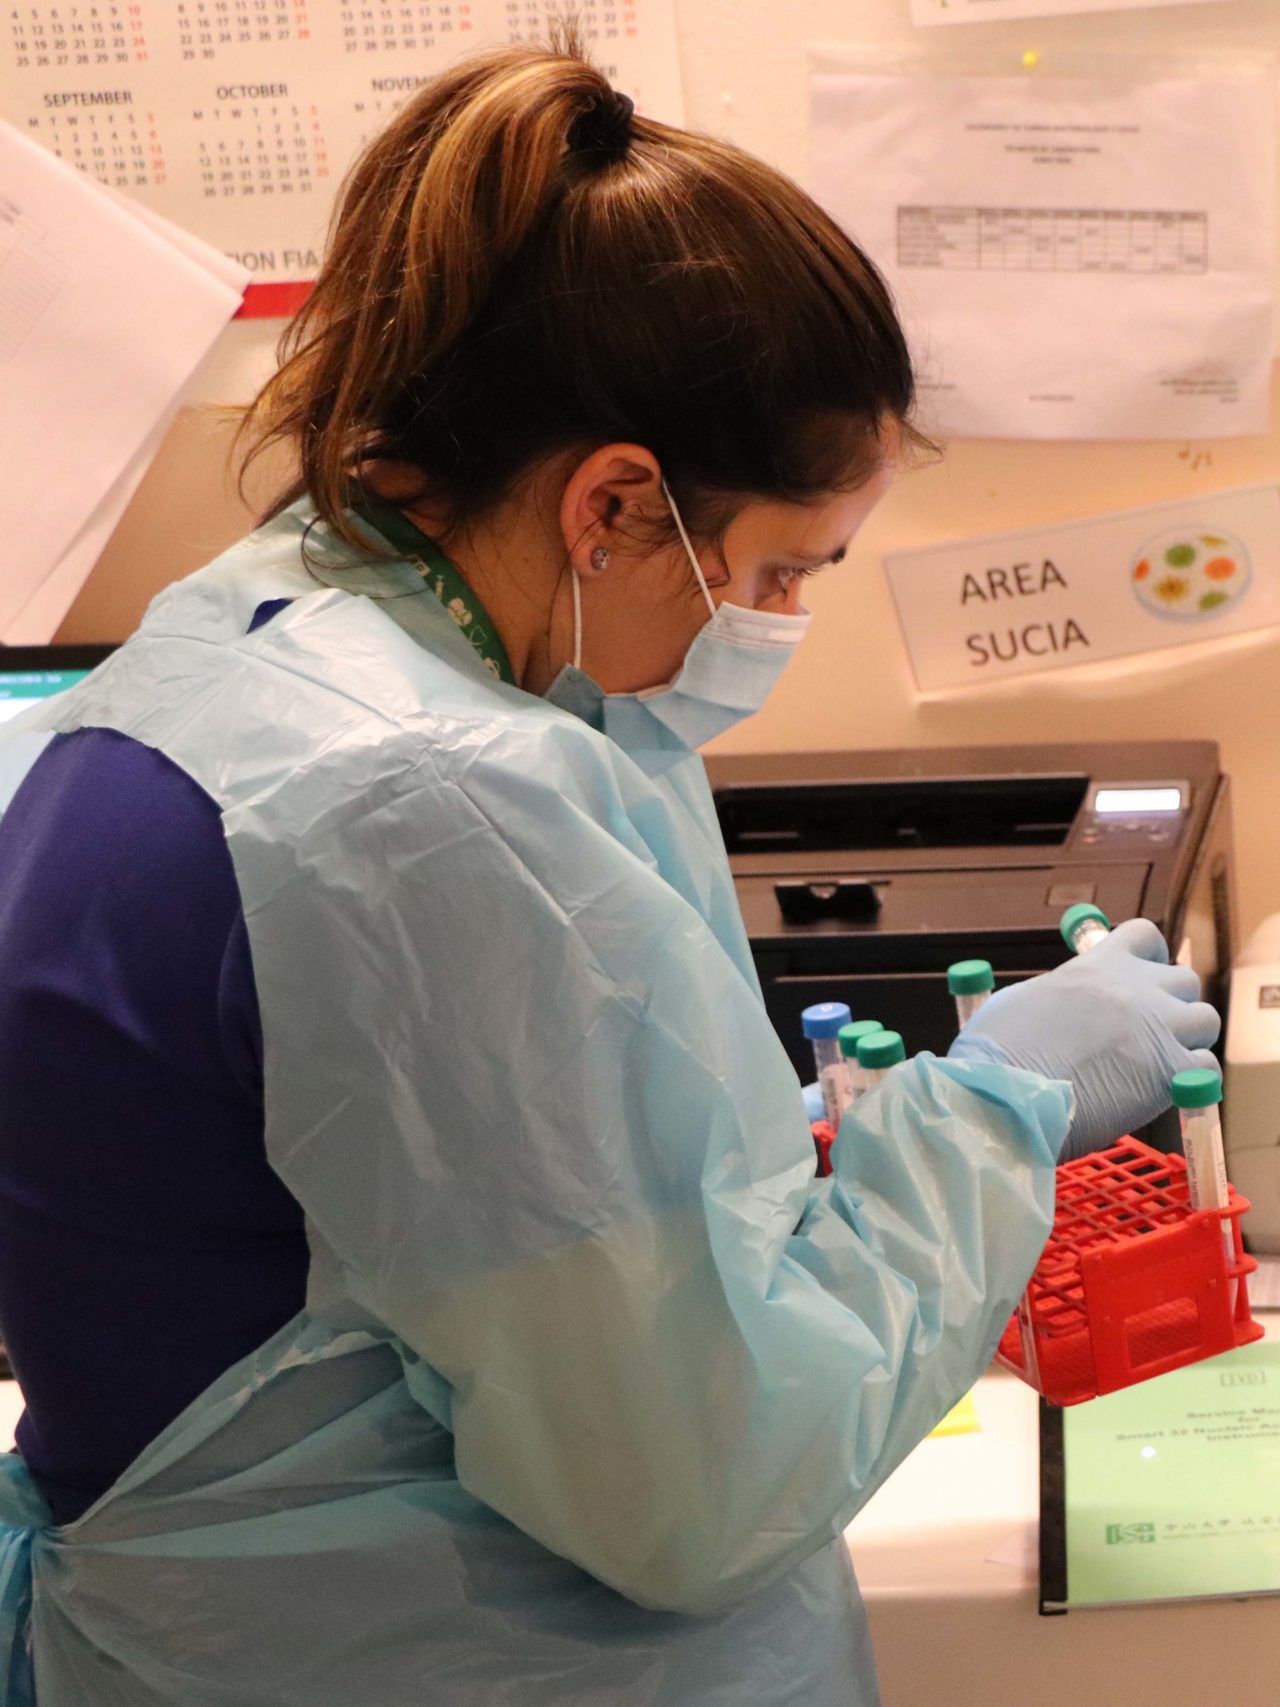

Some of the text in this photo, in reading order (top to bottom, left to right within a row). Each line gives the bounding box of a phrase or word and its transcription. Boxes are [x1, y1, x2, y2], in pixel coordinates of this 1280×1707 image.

[217, 84, 287, 99] OCTOBER
[372, 78, 428, 91] NOVEM
[44, 91, 132, 107] SEPTEMBER
[961, 559, 1067, 606] AREA
[966, 618, 1090, 667] SUCIA
